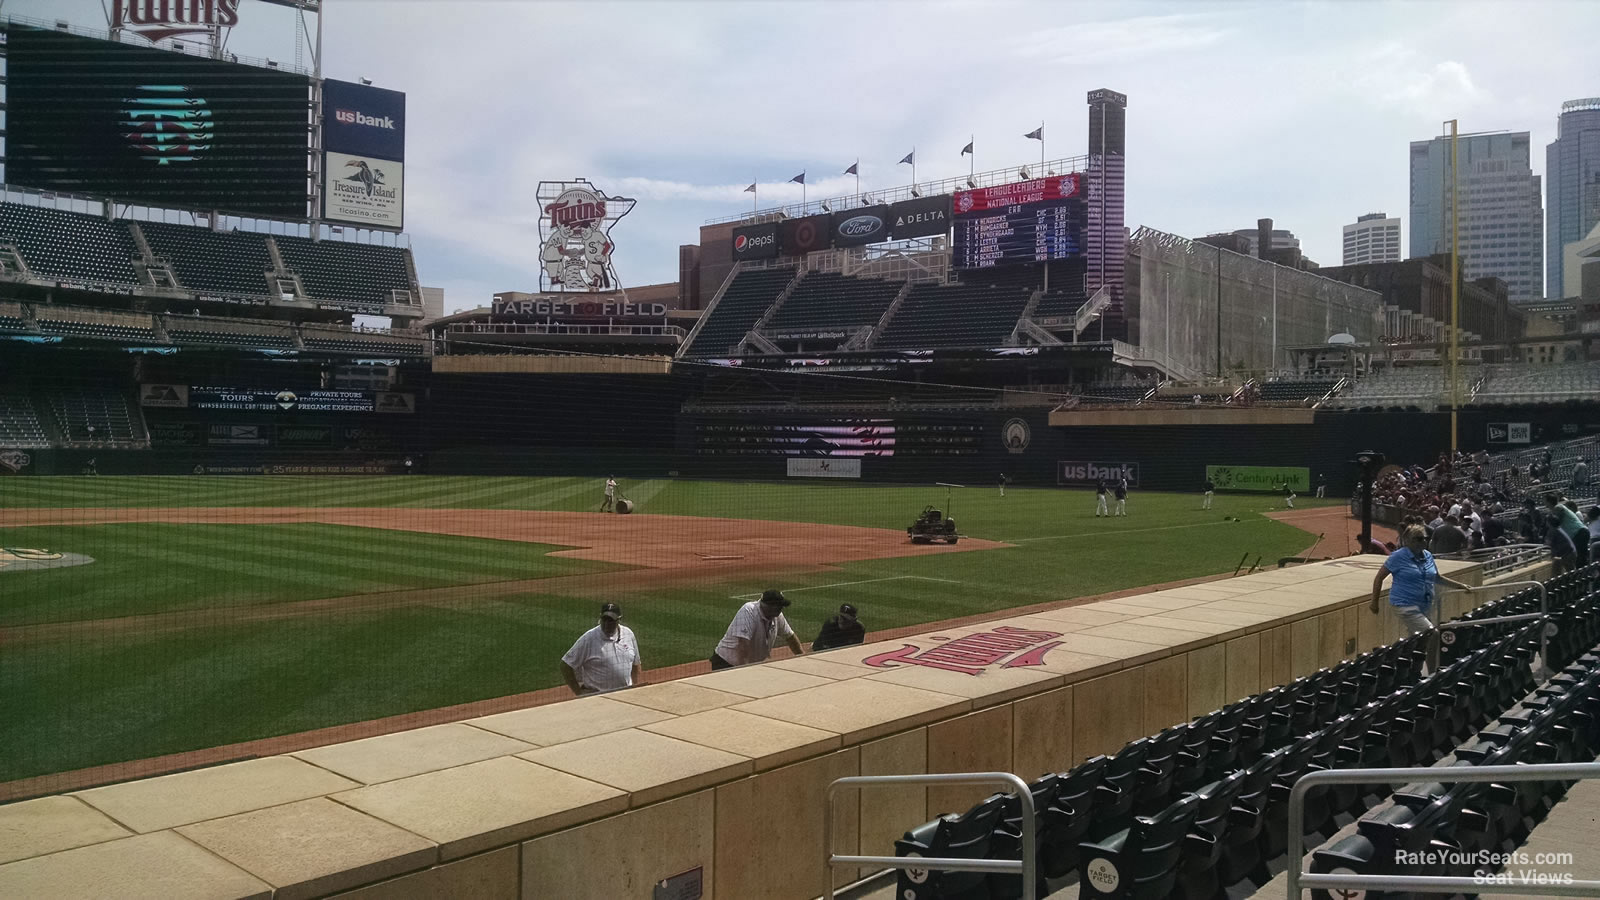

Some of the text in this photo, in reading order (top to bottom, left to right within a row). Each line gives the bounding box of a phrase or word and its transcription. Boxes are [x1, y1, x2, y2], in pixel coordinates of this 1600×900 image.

[333, 180, 396, 198] Treasure Island
[985, 180, 1046, 198] LEAGUE LEADERS
[987, 192, 1044, 208] NATIONAL LEAGUE
[544, 199, 606, 228] Twins
[1008, 206, 1021, 214] ERA
[907, 210, 944, 224] DELTA
[846, 220, 874, 235] Ford
[748, 233, 775, 248] pepsi
[980, 238, 997, 246] LESTER
[980, 245, 999, 253] ARRIETA
[980, 251, 1003, 260] SCHERZER
[493, 301, 666, 316] TARGET FIELD
[220, 394, 254, 402] TOURS
[332, 404, 374, 412] EXPERIENCE
[14, 455, 29, 464] 29
[273, 466, 285, 474] 25
[1236, 473, 1300, 485] CenturyLink
[862, 626, 1064, 676] Twins
[1090, 870, 1116, 880] TARGET
[1093, 876, 1112, 884] FIELD
